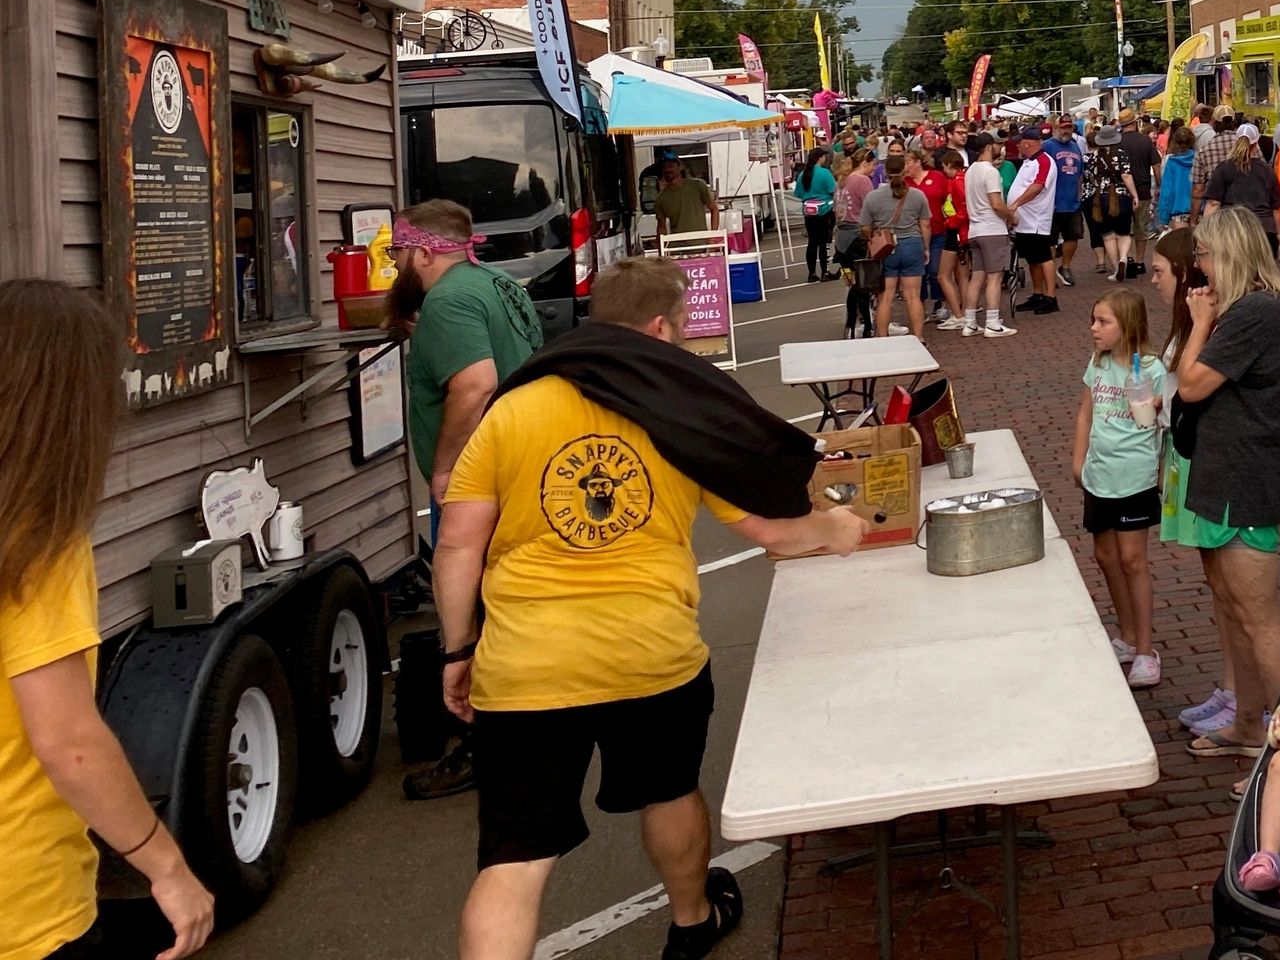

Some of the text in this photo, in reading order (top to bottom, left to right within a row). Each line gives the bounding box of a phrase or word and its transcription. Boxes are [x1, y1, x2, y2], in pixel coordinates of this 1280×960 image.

[687, 267, 706, 278] ICE
[687, 279, 719, 291] EAM
[687, 294, 718, 305] OATS
[687, 309, 721, 321] ODIES
[556, 443, 639, 481] SNAPPY'S
[555, 506, 639, 541] BARBECUE
